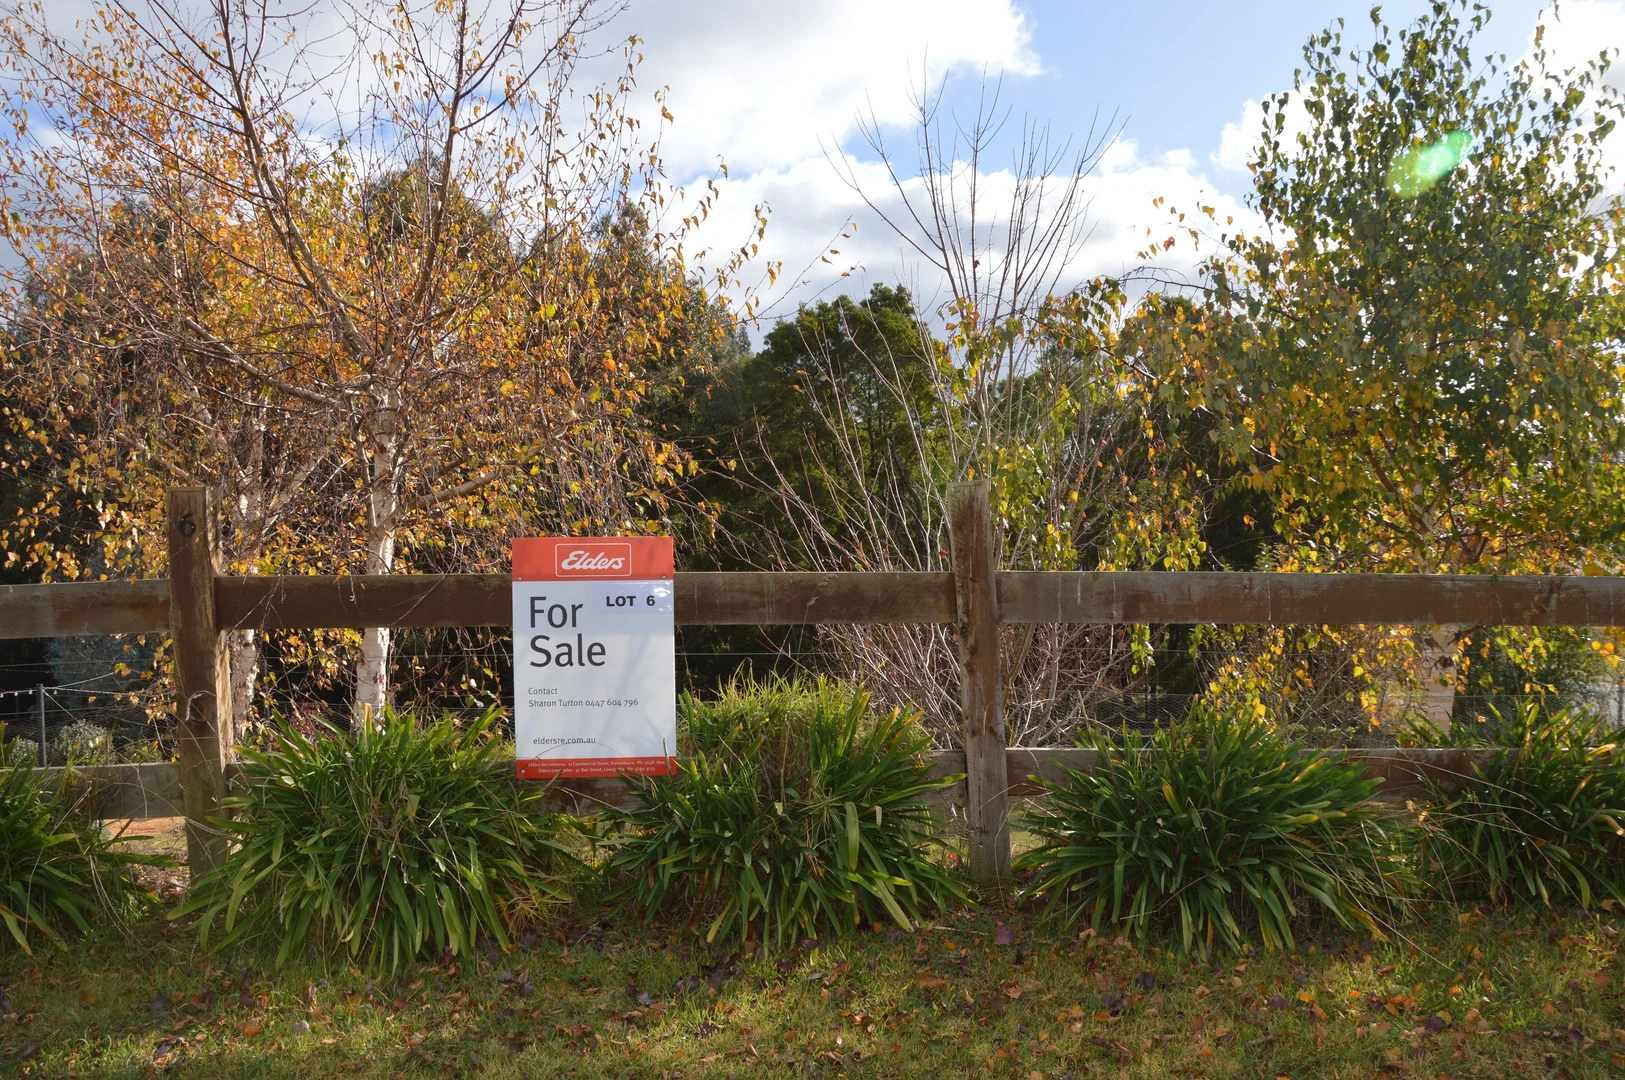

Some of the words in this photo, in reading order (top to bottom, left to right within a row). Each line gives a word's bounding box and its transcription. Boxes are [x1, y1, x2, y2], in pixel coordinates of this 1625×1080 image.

[561, 550, 625, 570] Elders
[606, 595, 636, 607] LOT
[646, 595, 656, 607] 6
[530, 596, 583, 628] For
[530, 633, 606, 668] Sale
[528, 687, 558, 695] Contact
[528, 699, 556, 708] Sharon
[559, 699, 583, 707] Turton
[585, 699, 605, 708] 0447
[606, 698, 622, 707] 604
[623, 698, 638, 707] 796
[533, 736, 596, 745] eldersre.com.au
